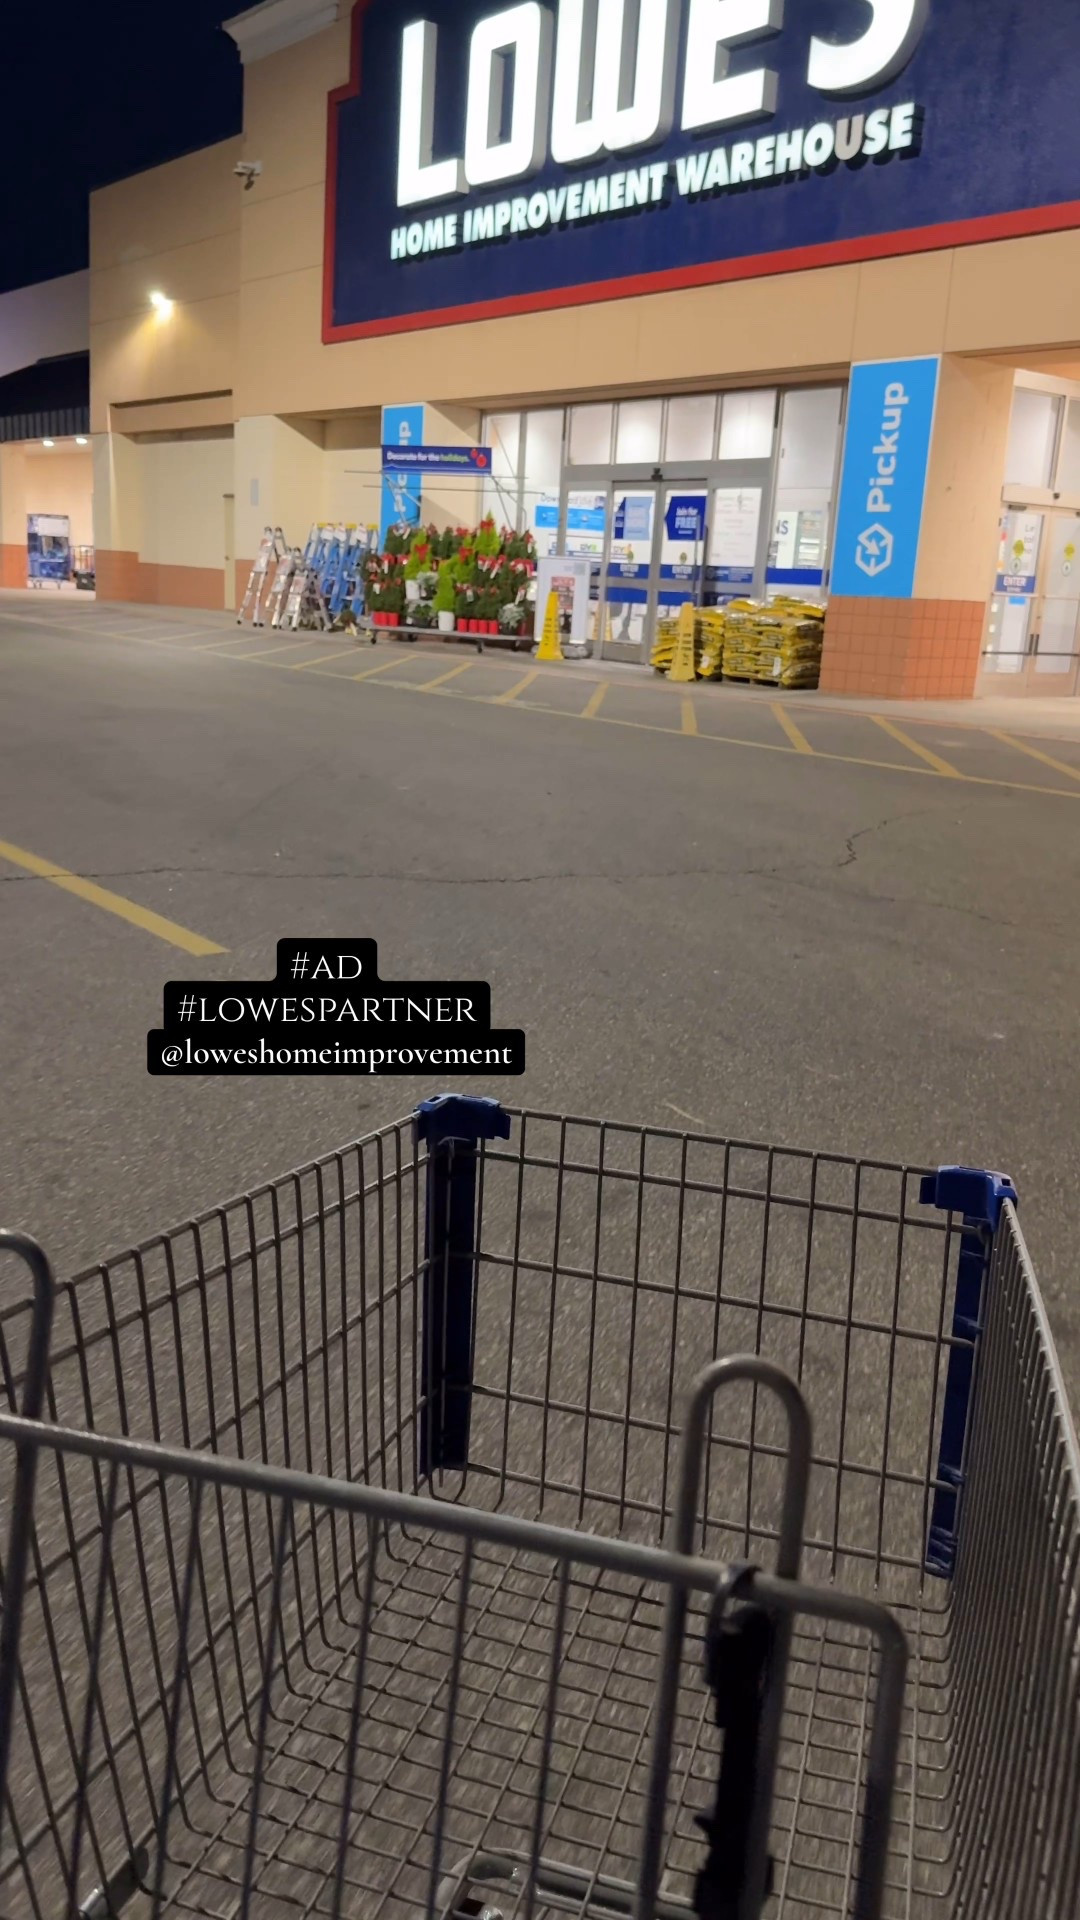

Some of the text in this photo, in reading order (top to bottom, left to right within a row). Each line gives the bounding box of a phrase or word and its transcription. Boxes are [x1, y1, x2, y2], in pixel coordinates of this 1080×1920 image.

[391, 102, 915, 260] HOME IMPROVEMENT WAREHOUSE
[387, 451, 417, 461] Decorate
[417, 452, 427, 461] for
[428, 452, 440, 461] the
[866, 382, 910, 513] Pickup
[675, 516, 697, 529] FREE
